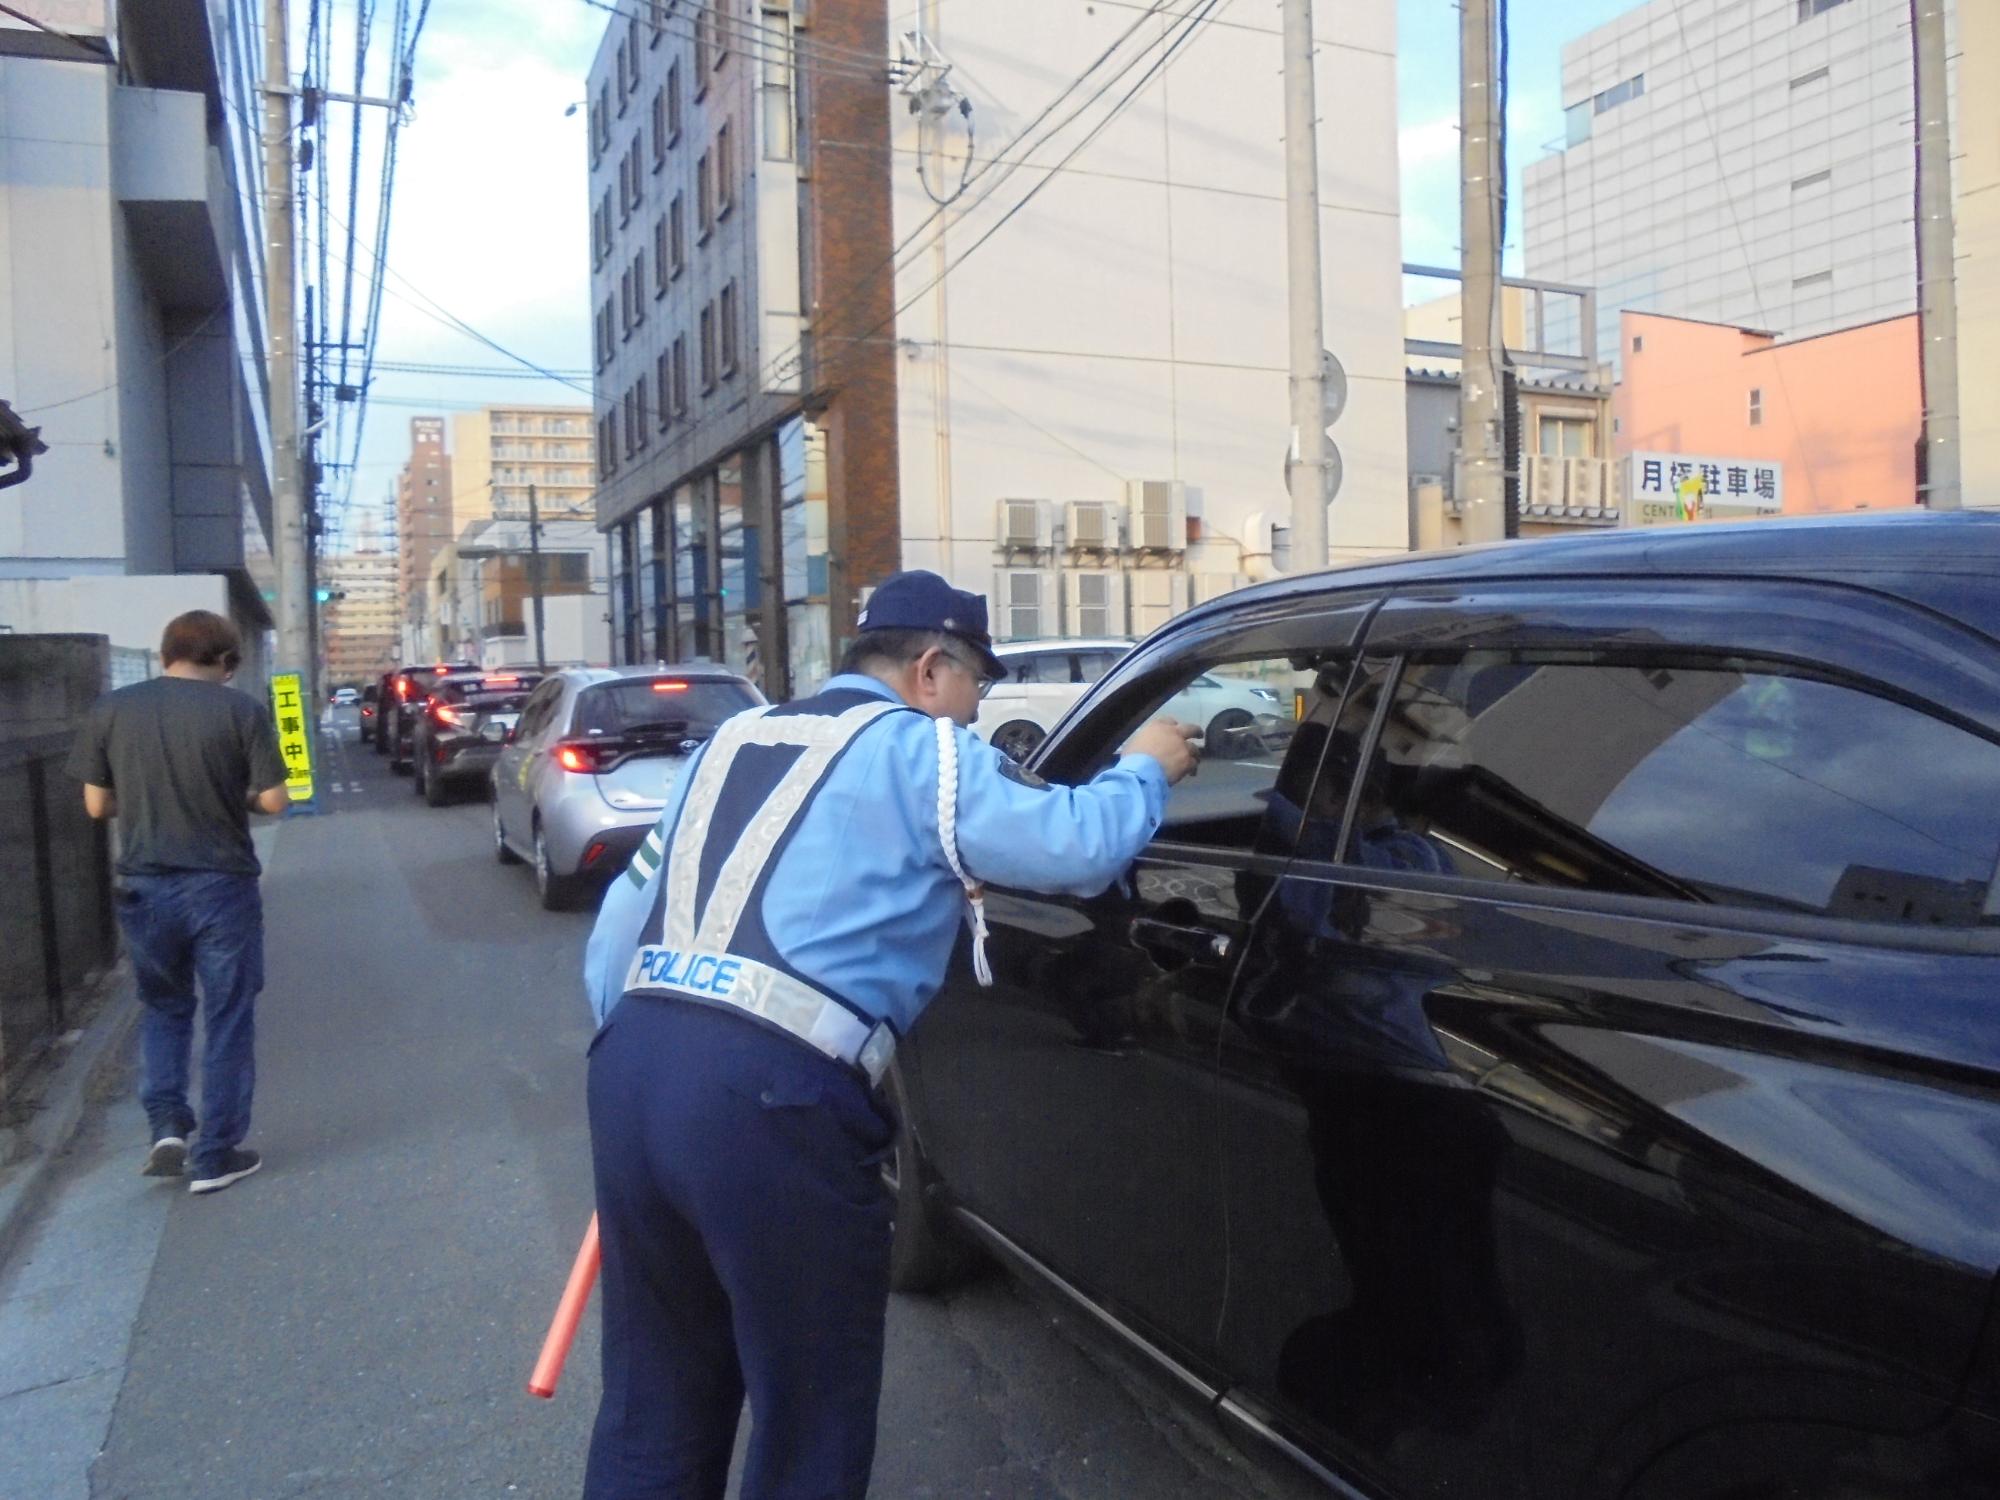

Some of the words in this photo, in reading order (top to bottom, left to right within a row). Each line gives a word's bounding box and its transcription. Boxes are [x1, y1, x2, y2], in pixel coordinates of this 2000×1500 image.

[279, 691, 303, 760] 工事中
[636, 951, 741, 994] POLICE
